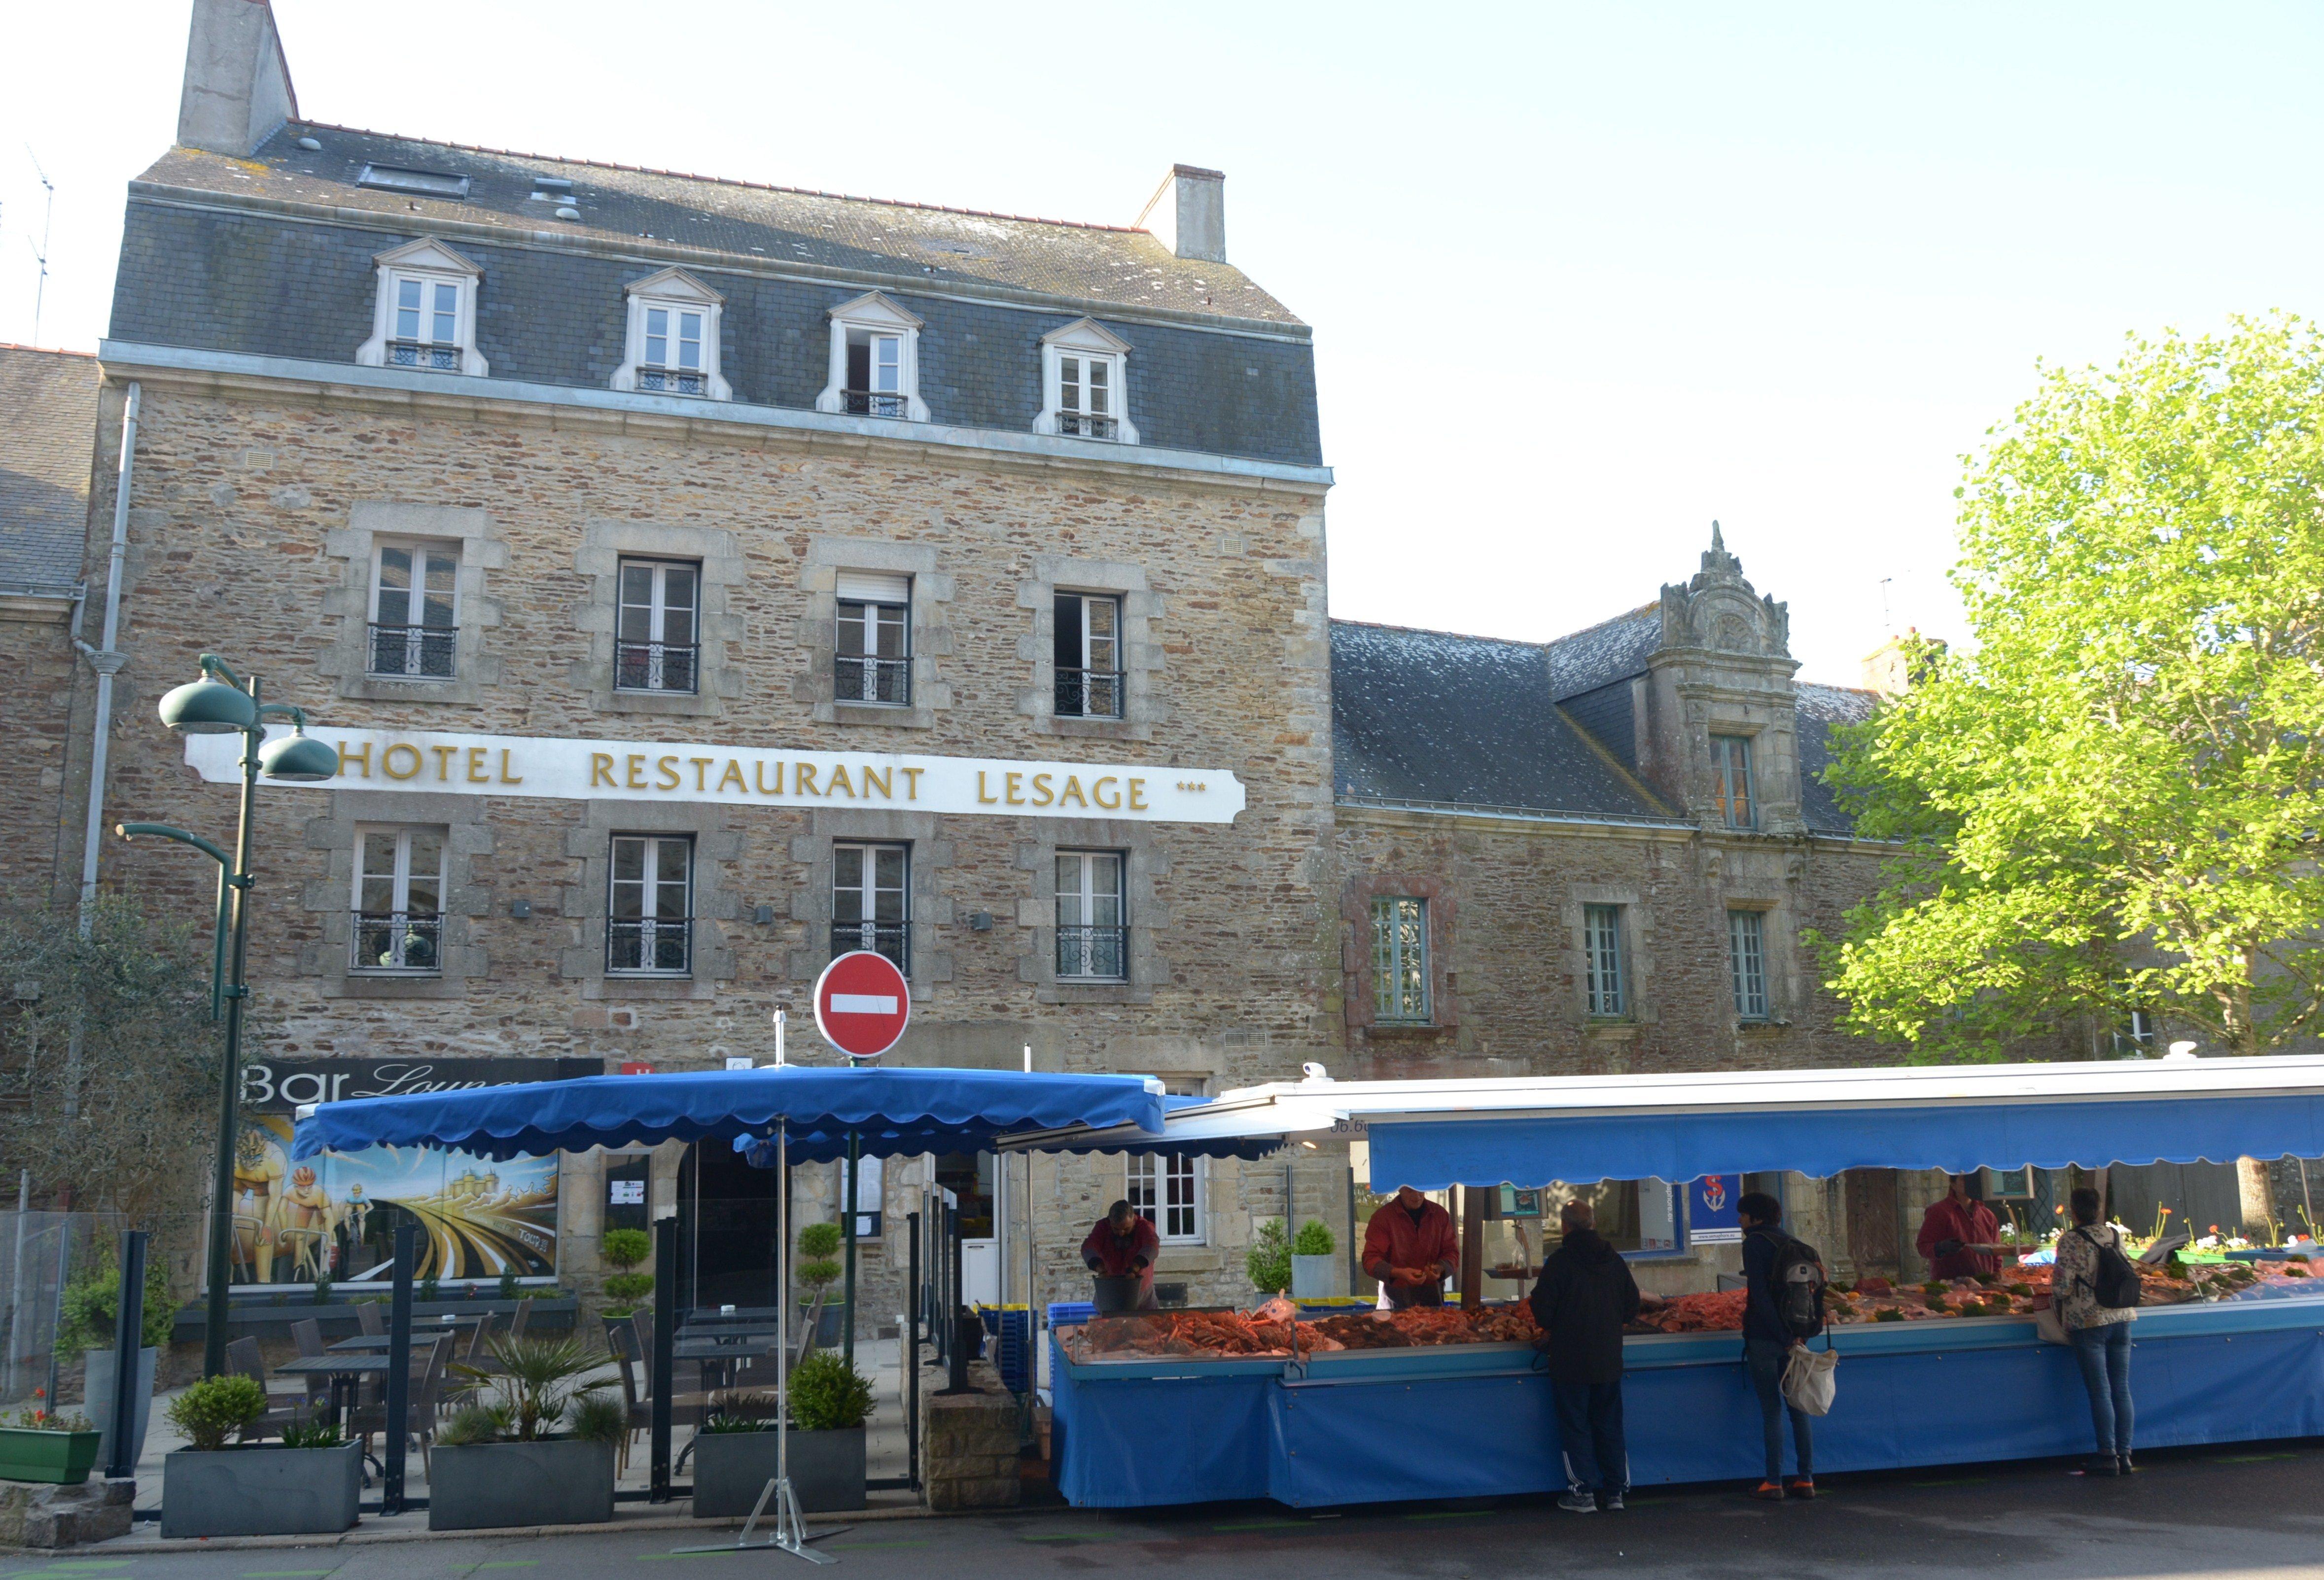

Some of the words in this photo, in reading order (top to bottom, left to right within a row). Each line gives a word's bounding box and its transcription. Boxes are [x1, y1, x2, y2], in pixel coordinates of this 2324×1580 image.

[337, 740, 523, 783] HOTEL
[590, 752, 925, 800] RESTAURANT
[978, 771, 1149, 809] LESAGE
[240, 1064, 350, 1104] Bar
